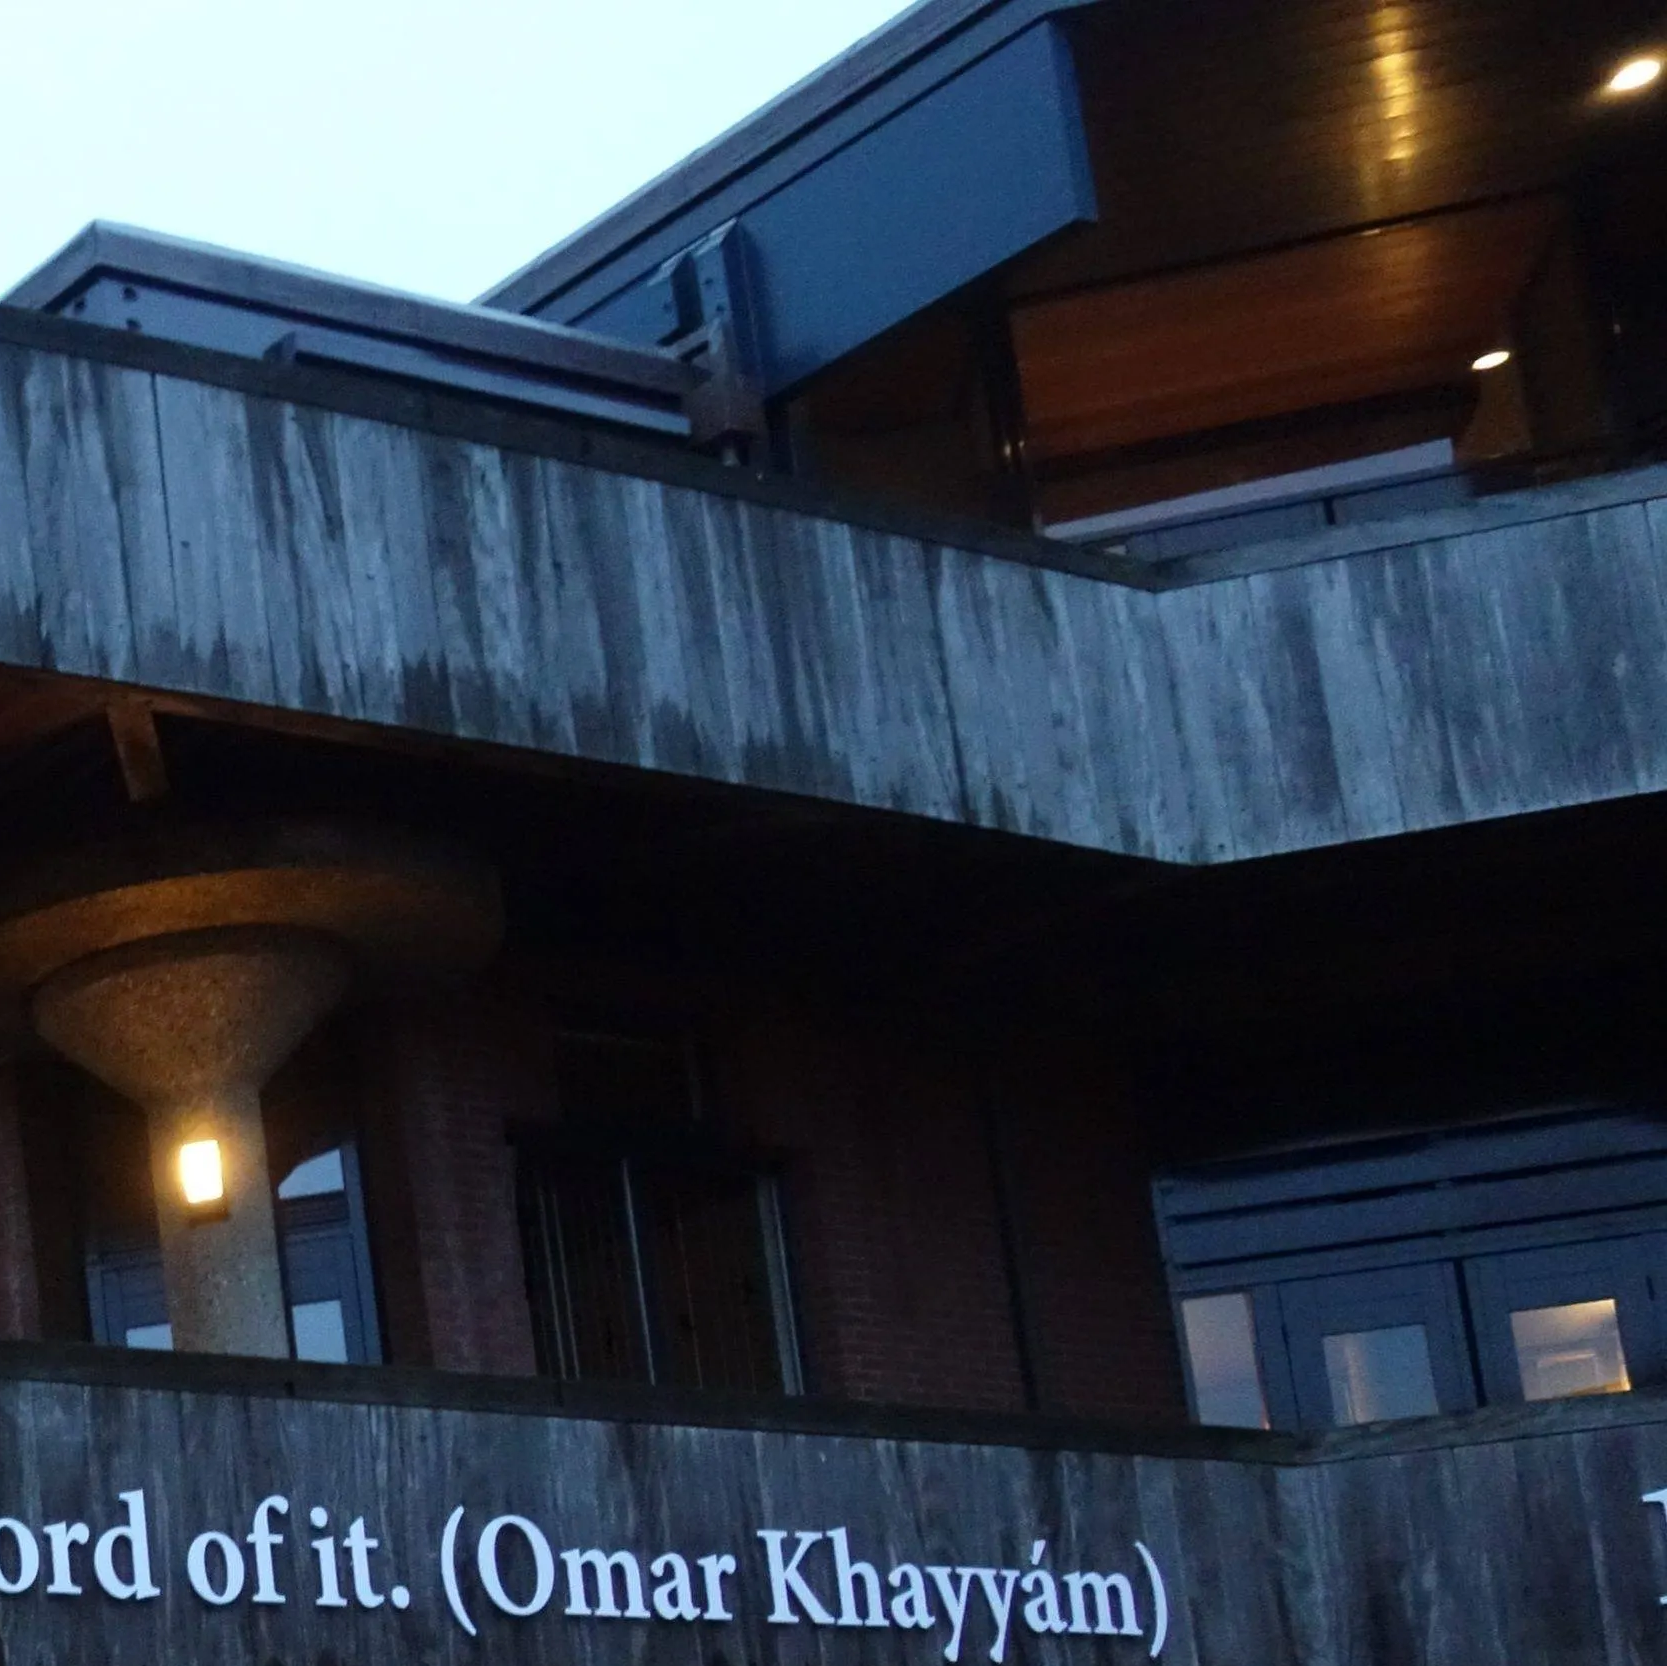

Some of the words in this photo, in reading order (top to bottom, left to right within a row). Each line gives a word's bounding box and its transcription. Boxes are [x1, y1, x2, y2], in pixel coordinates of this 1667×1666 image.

[186, 1495, 289, 1606] of
[310, 1506, 411, 1609] it.
[440, 1505, 736, 1637] (Omar
[755, 1527, 1169, 1663] Khayyám)
